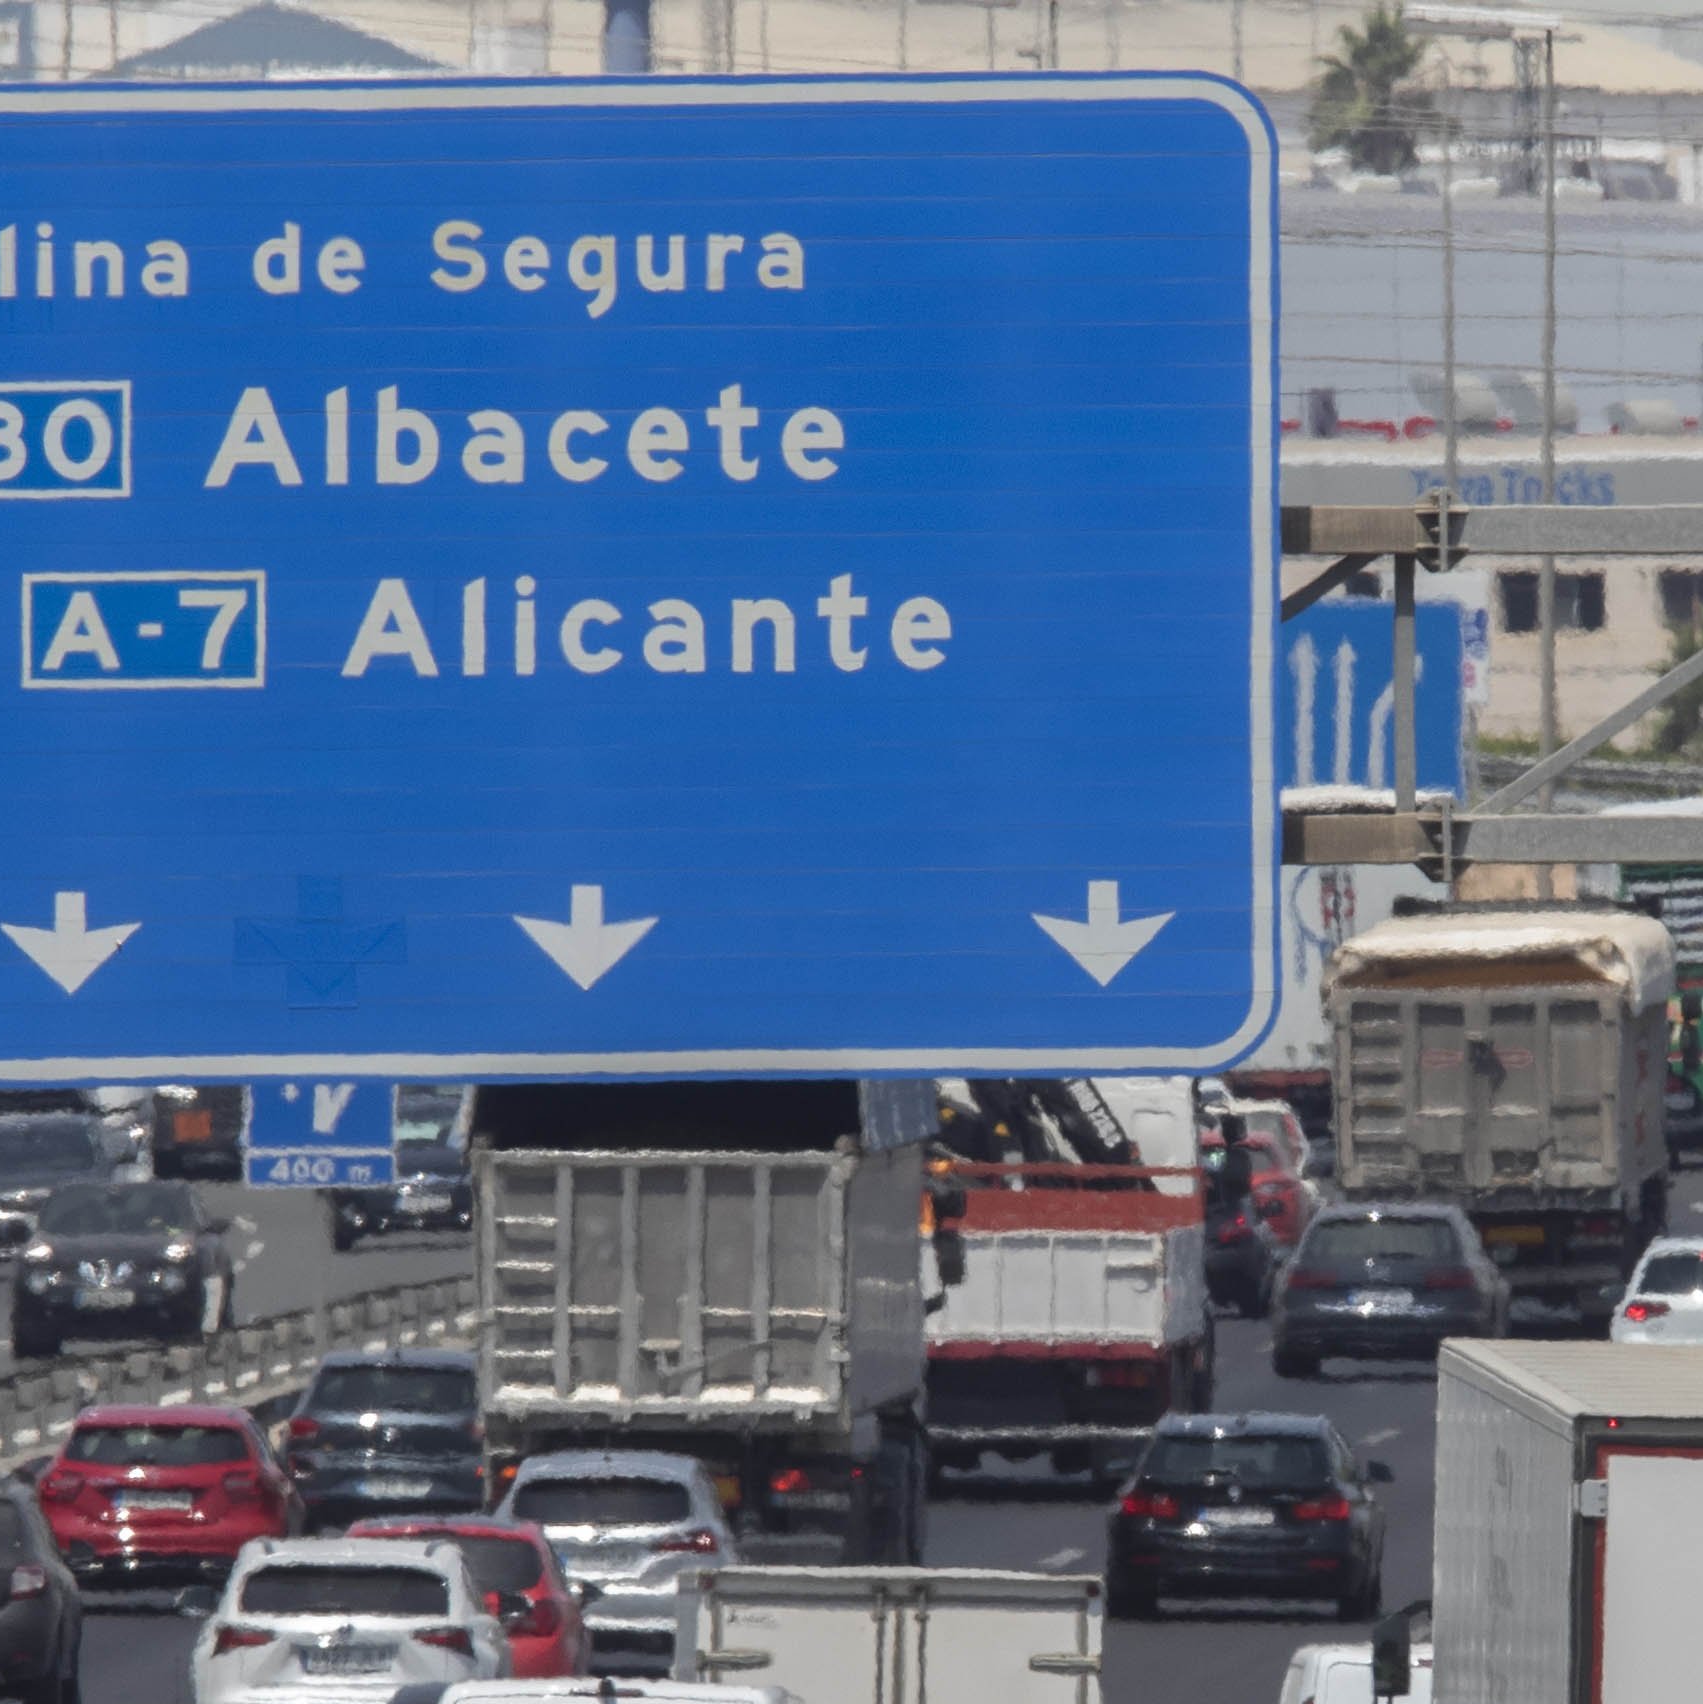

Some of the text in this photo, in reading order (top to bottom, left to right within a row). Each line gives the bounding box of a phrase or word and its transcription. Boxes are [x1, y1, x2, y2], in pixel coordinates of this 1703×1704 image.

[254, 222, 364, 294] de
[432, 220, 804, 318] Segura
[205, 385, 845, 487] Albacete
[41, 591, 246, 670] A-7
[342, 575, 952, 677] Alicante
[268, 1157, 336, 1182] 400
